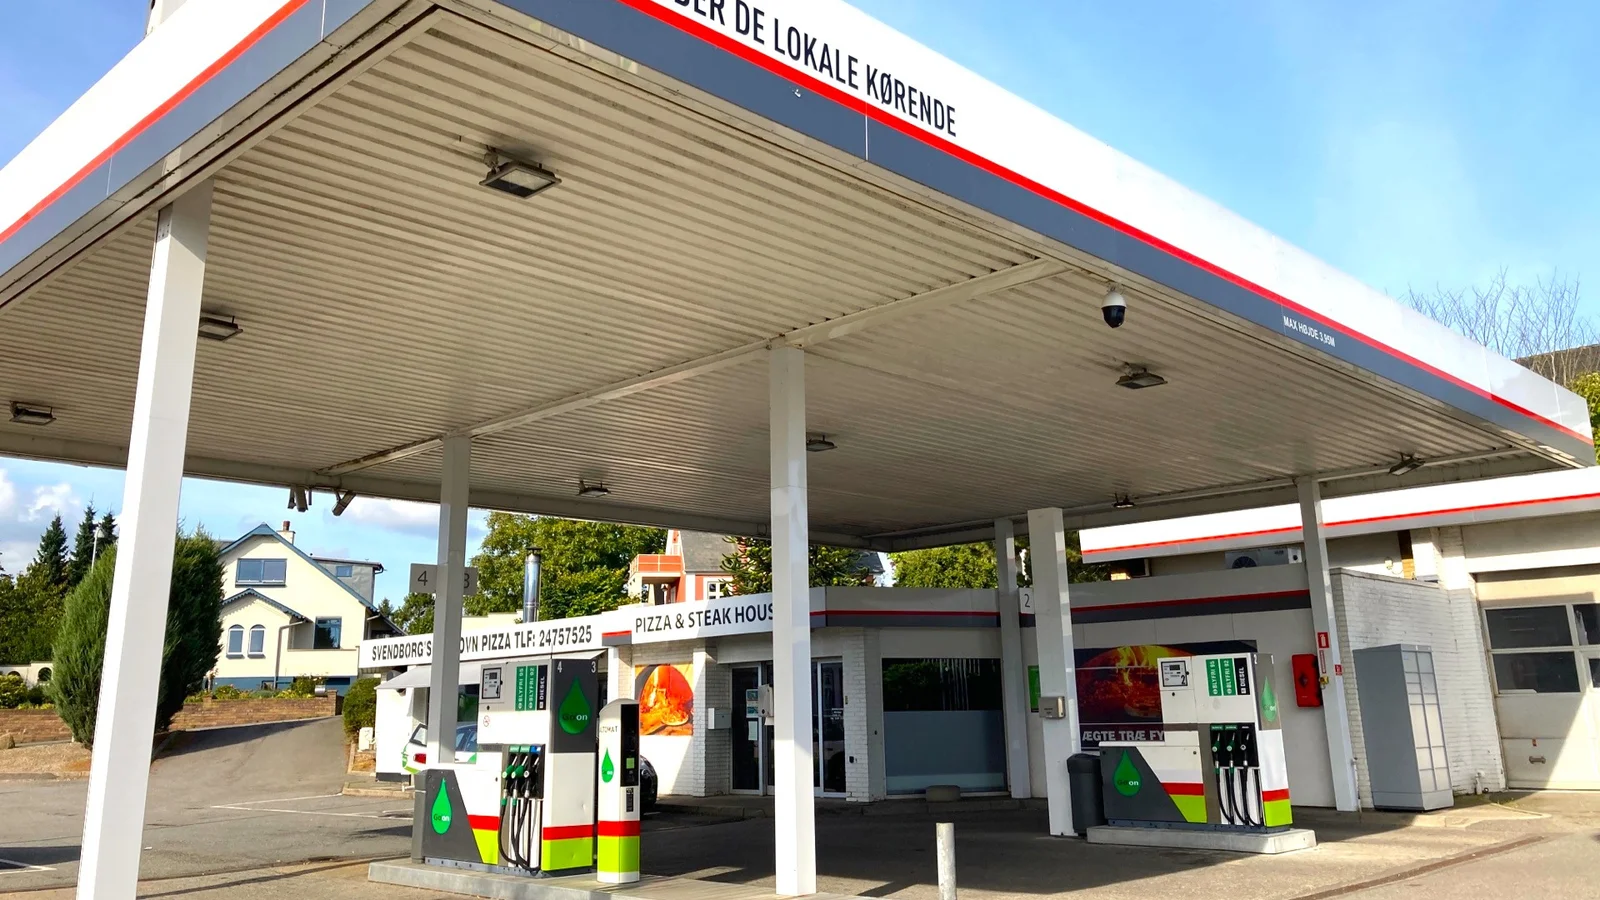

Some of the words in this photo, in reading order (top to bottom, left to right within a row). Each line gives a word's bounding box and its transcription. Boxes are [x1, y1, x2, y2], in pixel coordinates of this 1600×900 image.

[674, 0, 725, 26] ER
[735, 0, 765, 45] DE
[774, 18, 859, 91] LOKALE
[866, 64, 957, 137] KØRENDE
[1283, 315, 1298, 331] MAX
[1299, 322, 1319, 340] HØJDE
[417, 570, 428, 586] 4
[1024, 593, 1031, 608] 2
[635, 615, 672, 633] PIZZA
[675, 613, 685, 629] &
[688, 607, 731, 628] STEAK
[372, 640, 432, 661] SVENDBORG'S
[481, 632, 511, 651] PIZZA
[514, 630, 536, 648] TLF:
[539, 625, 592, 647] 24757525
[557, 661, 563, 673] 4
[591, 661, 597, 673] 3
[1238, 667, 1246, 687] DIESEL
[1180, 674, 1187, 685] 2
[1210, 668, 1218, 689] BLYFRI
[1224, 668, 1232, 688] BLYFRI
[1082, 730, 1117, 741] ÆGTE
[1119, 730, 1147, 741] TRÆ
